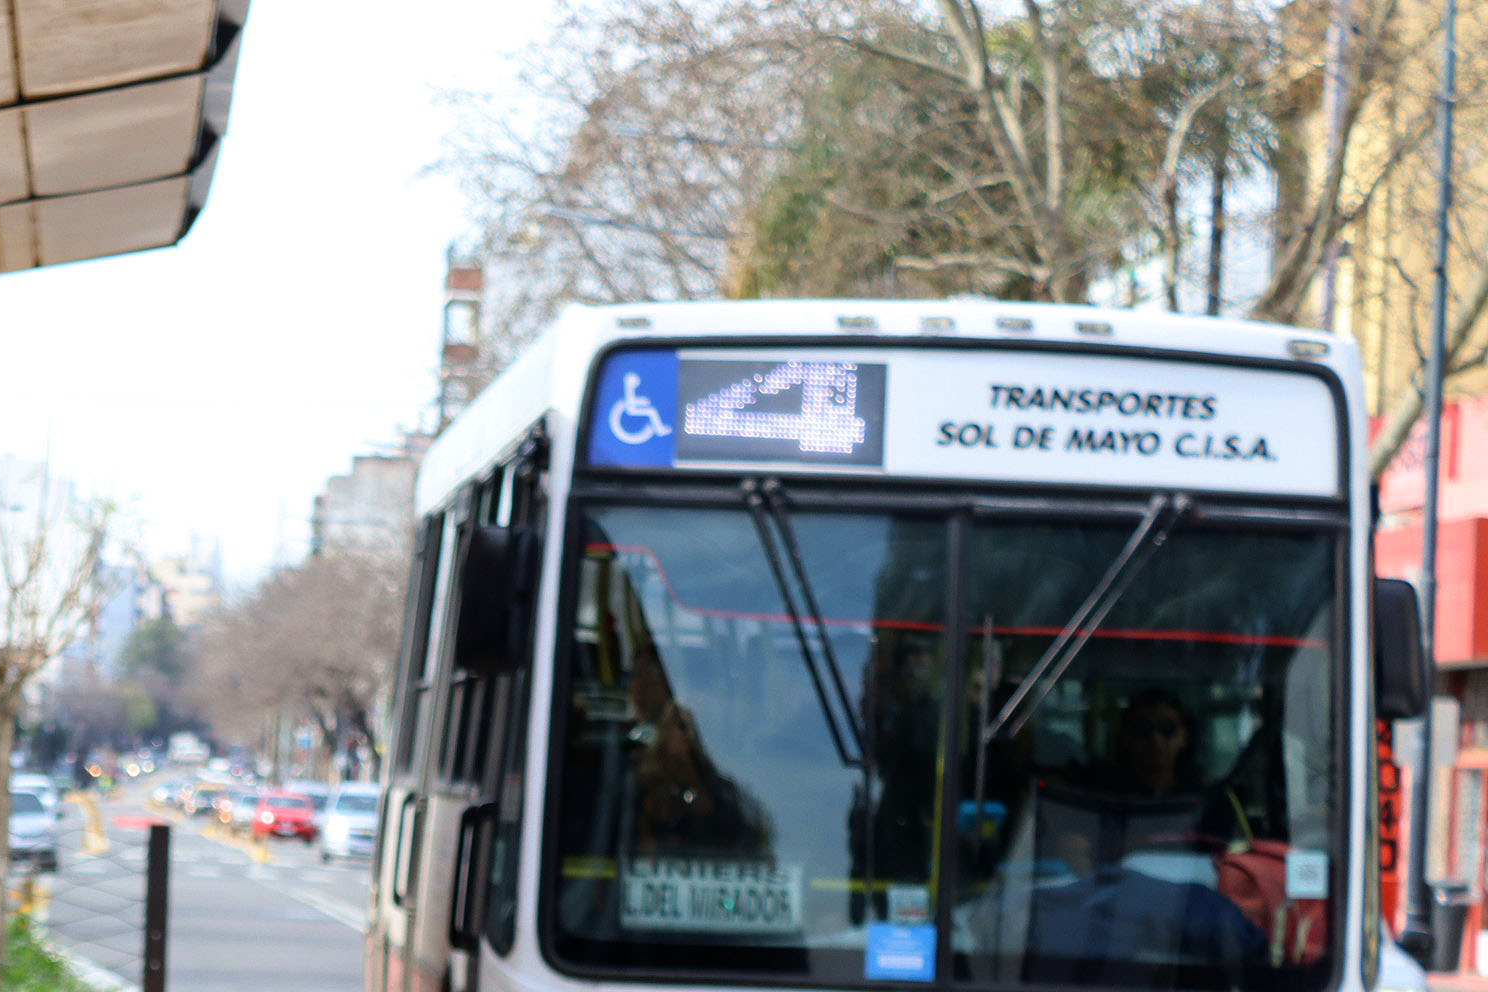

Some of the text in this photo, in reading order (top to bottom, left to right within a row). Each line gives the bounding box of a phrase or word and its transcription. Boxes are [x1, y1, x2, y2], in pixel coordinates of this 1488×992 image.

[684, 359, 865, 453] 4
[989, 384, 1217, 420] TRANSPORTES
[936, 422, 1278, 462] SOL DE MAYO C.I.S.A.
